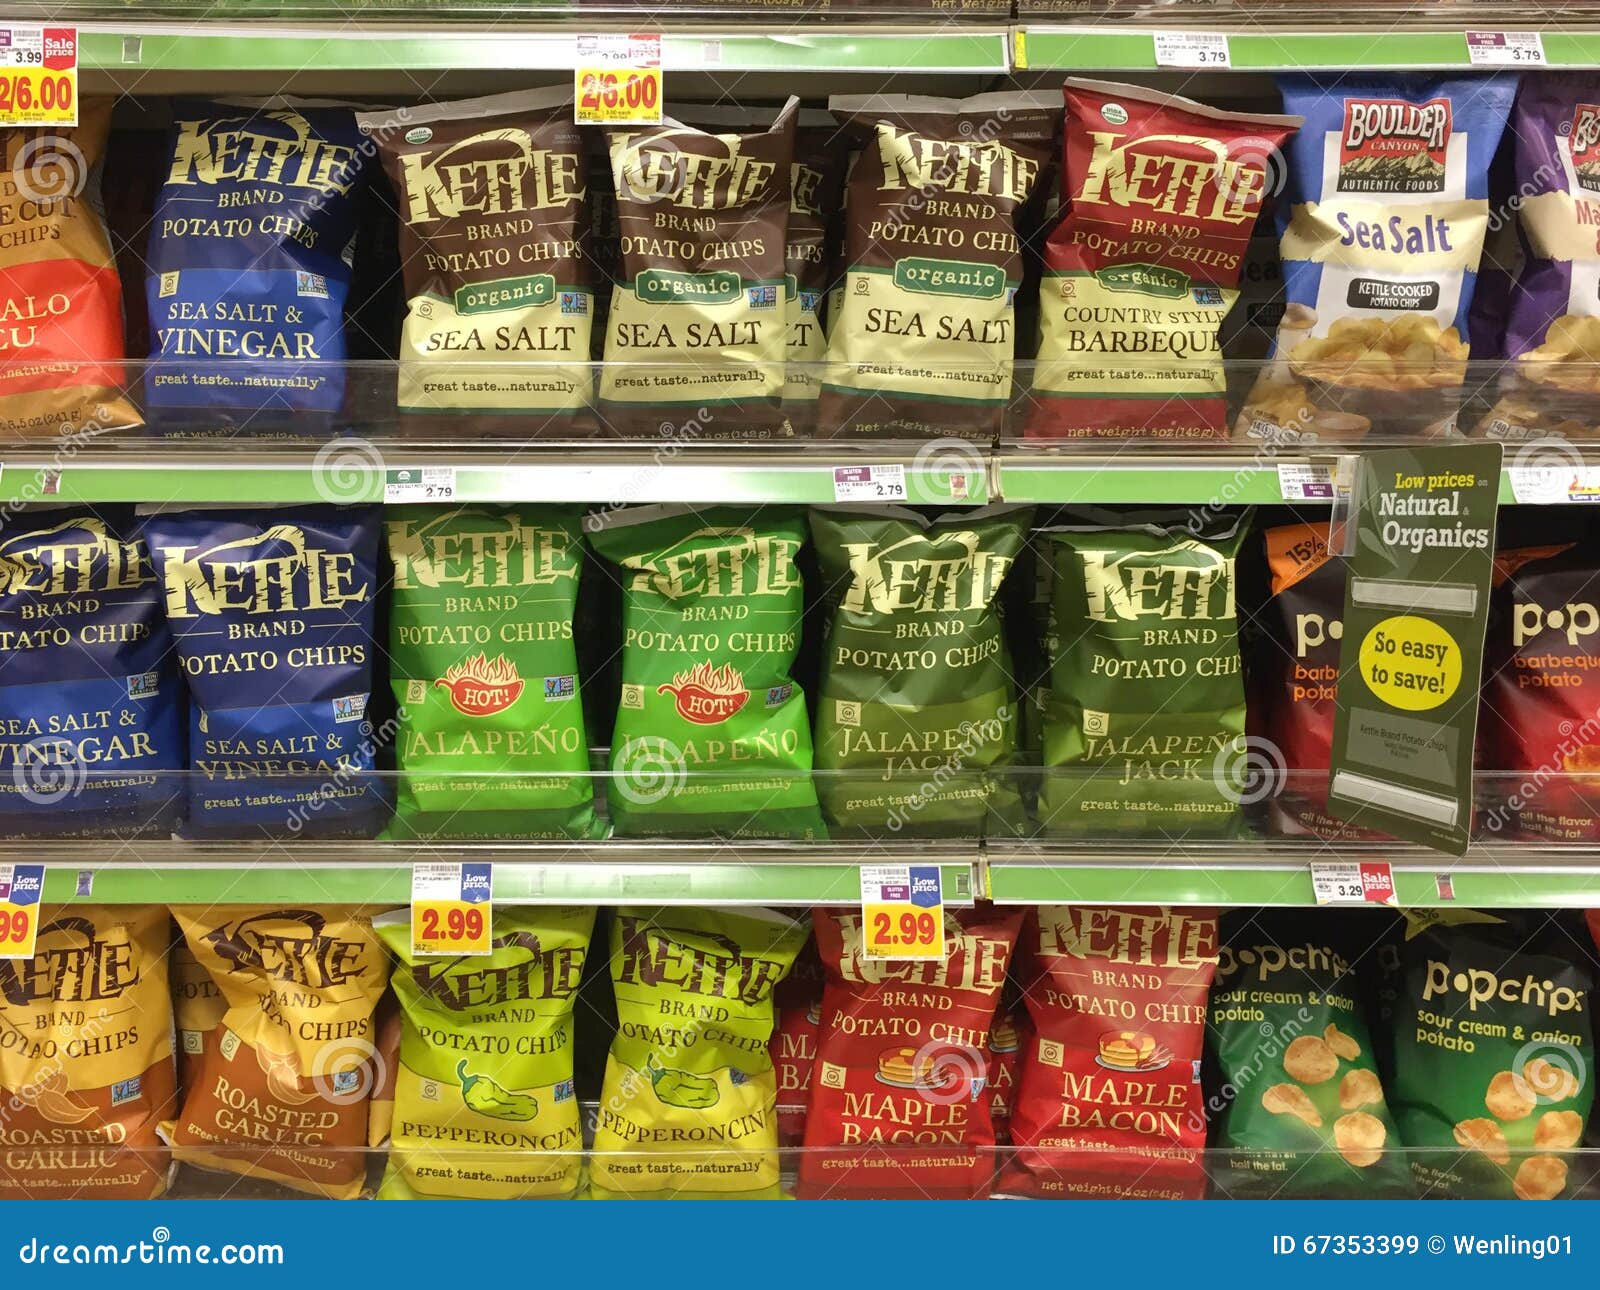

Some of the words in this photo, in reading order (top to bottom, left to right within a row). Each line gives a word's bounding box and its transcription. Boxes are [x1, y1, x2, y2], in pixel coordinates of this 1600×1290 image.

[45, 38, 74, 49] Sale
[45, 48, 74, 58] price
[15, 51, 42, 63] 3.99
[1199, 51, 1226, 62] 3.79
[1512, 50, 1541, 60] 3.79
[1346, 102, 1448, 149] BOULDER
[1370, 141, 1420, 151] CANYON
[607, 129, 776, 210] KETTLE
[874, 119, 1040, 204] KETTLE
[397, 128, 588, 226] KETTLE
[1072, 130, 1266, 225] KETTLE
[1342, 179, 1402, 191] AUTHENTIC
[1406, 179, 1440, 191] FOODS
[217, 190, 284, 208] BRAND
[925, 200, 996, 220] BRAND
[162, 218, 251, 240] POTATO
[467, 218, 533, 241] BRAND
[654, 212, 716, 232] BRAND
[1130, 218, 1200, 240] BRAND
[1337, 212, 1386, 251] Sea
[1390, 214, 1454, 254] Salt
[868, 221, 965, 248] POTATO
[424, 248, 510, 272] POTATO
[518, 239, 583, 264] CHIPS
[702, 238, 765, 261] CHIPS
[1071, 231, 1163, 258] POTATO
[1168, 244, 1241, 270] CHIPS
[647, 279, 731, 295] organic
[906, 267, 995, 288] organic
[466, 282, 545, 307] organic
[1358, 281, 1390, 296] KETTLE
[1391, 283, 1432, 297] COOKED
[168, 302, 208, 321] SEA
[215, 303, 276, 324] SALT
[285, 306, 302, 324] &
[1369, 296, 1399, 307] POTATO
[1400, 297, 1420, 308] CHIPS
[864, 307, 926, 338] SEA
[936, 315, 1011, 344] SALT
[1063, 306, 1163, 325] COUNTRY
[158, 327, 320, 360] VINEGAR
[426, 328, 486, 352] SEA
[495, 326, 576, 351] SALT
[616, 322, 676, 348] SEA
[686, 320, 761, 347] SALT
[857, 363, 893, 376] great
[1067, 369, 1104, 381] great
[155, 374, 187, 388] great
[424, 381, 457, 393] great
[614, 376, 650, 388] great
[426, 487, 452, 498] 2.79
[876, 484, 903, 496] 2.79
[1395, 472, 1426, 489] Low
[1427, 471, 1476, 493] prices
[1378, 491, 1460, 516] Natural
[1382, 520, 1489, 554] Organics
[384, 509, 579, 590] KETTLE
[155, 524, 370, 619] KETTLE
[620, 526, 802, 601] KETTLE
[21, 599, 100, 620] BRAND
[445, 595, 518, 613] BRAND
[682, 604, 749, 622] BRAND
[228, 619, 305, 640] BRAND
[398, 625, 491, 646] POTATO
[500, 620, 574, 643] CHIPS
[624, 628, 720, 653] POTATO
[728, 632, 795, 653] CHIPS
[895, 620, 965, 639] BRAND
[1143, 628, 1218, 646] BRAND
[287, 644, 366, 668] CHIPS
[836, 646, 937, 671] POTATO
[945, 634, 1000, 668] CHIPS
[1375, 631, 1396, 654] So
[1402, 640, 1449, 667] easy
[1091, 654, 1187, 679] POTATO
[1371, 664, 1389, 685] to
[1394, 671, 1447, 695] save!
[1519, 671, 1583, 689] potato
[462, 687, 510, 707] HOT!
[687, 695, 735, 716] HOT!
[48, 710, 112, 734] SALT
[205, 739, 252, 756] SEA
[256, 735, 318, 756] SALT
[402, 723, 580, 763] JALAPEÑO
[620, 727, 798, 764] JALAPEÑO
[838, 719, 1003, 758] JALAPEÑO
[196, 753, 362, 782] VINEGAR
[1119, 758, 1203, 785] JACK
[204, 797, 241, 811] great
[846, 797, 884, 810] great
[1080, 800, 1119, 811] great
[13, 882, 39, 892] price
[17, 875, 38, 884] Low
[463, 880, 490, 890] price
[465, 873, 487, 882] Low
[914, 876, 935, 885] Low
[1362, 872, 1389, 884] Sale
[1365, 881, 1391, 892] price
[912, 884, 938, 895] price
[1338, 885, 1363, 897] 3.29
[422, 908, 483, 941] 2.99
[873, 912, 936, 945] 2.99
[1091, 969, 1163, 990] BRAND
[882, 991, 953, 1011] BRAND
[1045, 989, 1136, 1020] POTATO
[1213, 989, 1248, 1005] sour
[1250, 991, 1303, 1005] cream
[472, 1008, 536, 1024] BRAND
[660, 999, 729, 1023] BRAND
[1214, 1006, 1265, 1024] potato
[299, 1017, 369, 1041] CHIPS
[831, 1009, 921, 1037] POTATO
[929, 1023, 988, 1049] CHIP
[1417, 1008, 1454, 1030] sour
[1458, 1019, 1507, 1038] cream
[1512, 1025, 1525, 1041] &
[1531, 1029, 1583, 1047] onion
[419, 1026, 510, 1055] POTATO
[1416, 1028, 1476, 1054] potato
[1061, 1071, 1188, 1108] MAPLE
[212, 1075, 339, 1129] ROASTED
[842, 1092, 969, 1127] MAPLE
[215, 1108, 324, 1148] GARLIC
[602, 1107, 767, 1143] PEPPERONCIN
[1058, 1102, 1184, 1137] BACON
[400, 1119, 581, 1152] PEPPERONCIN
[840, 1122, 967, 1146] BACON
[415, 1166, 453, 1178] great
[608, 1162, 642, 1174] great
[822, 1158, 858, 1169] great
[1252, 1159, 1270, 1171] the
[1041, 1181, 1064, 1191] net
[1067, 1182, 1111, 1194] weight
